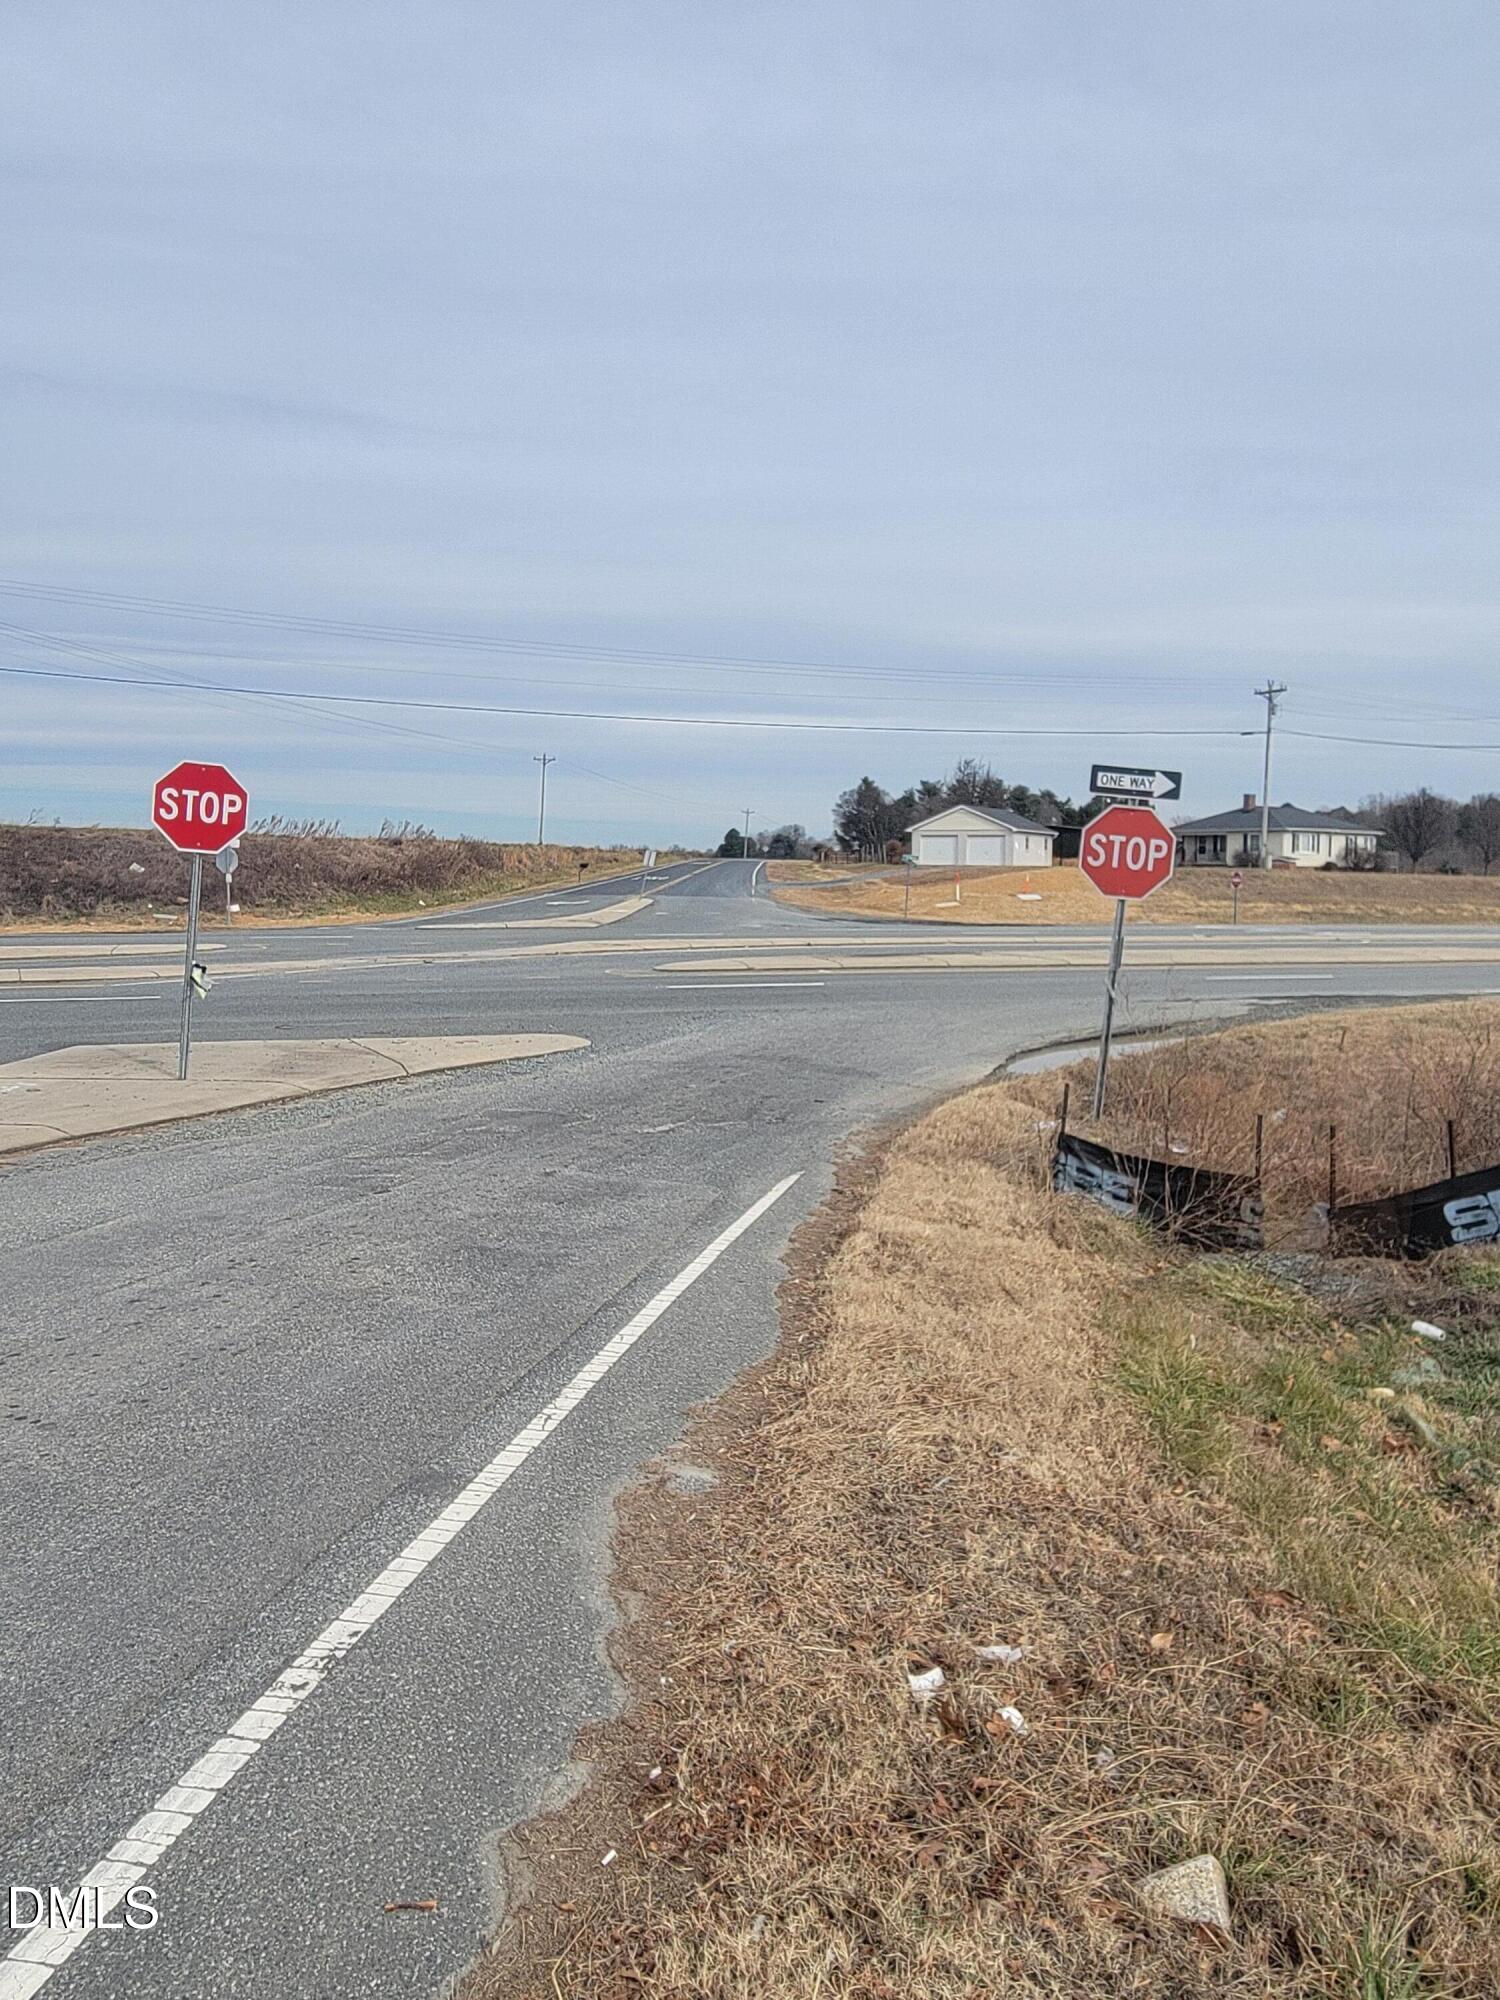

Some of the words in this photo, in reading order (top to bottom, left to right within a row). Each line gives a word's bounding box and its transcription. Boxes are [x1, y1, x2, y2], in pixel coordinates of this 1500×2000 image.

[1100, 774, 1126, 787] ONE
[1129, 777, 1156, 789] WAY
[159, 787, 243, 825] STOP
[1086, 833, 1169, 872] STOP
